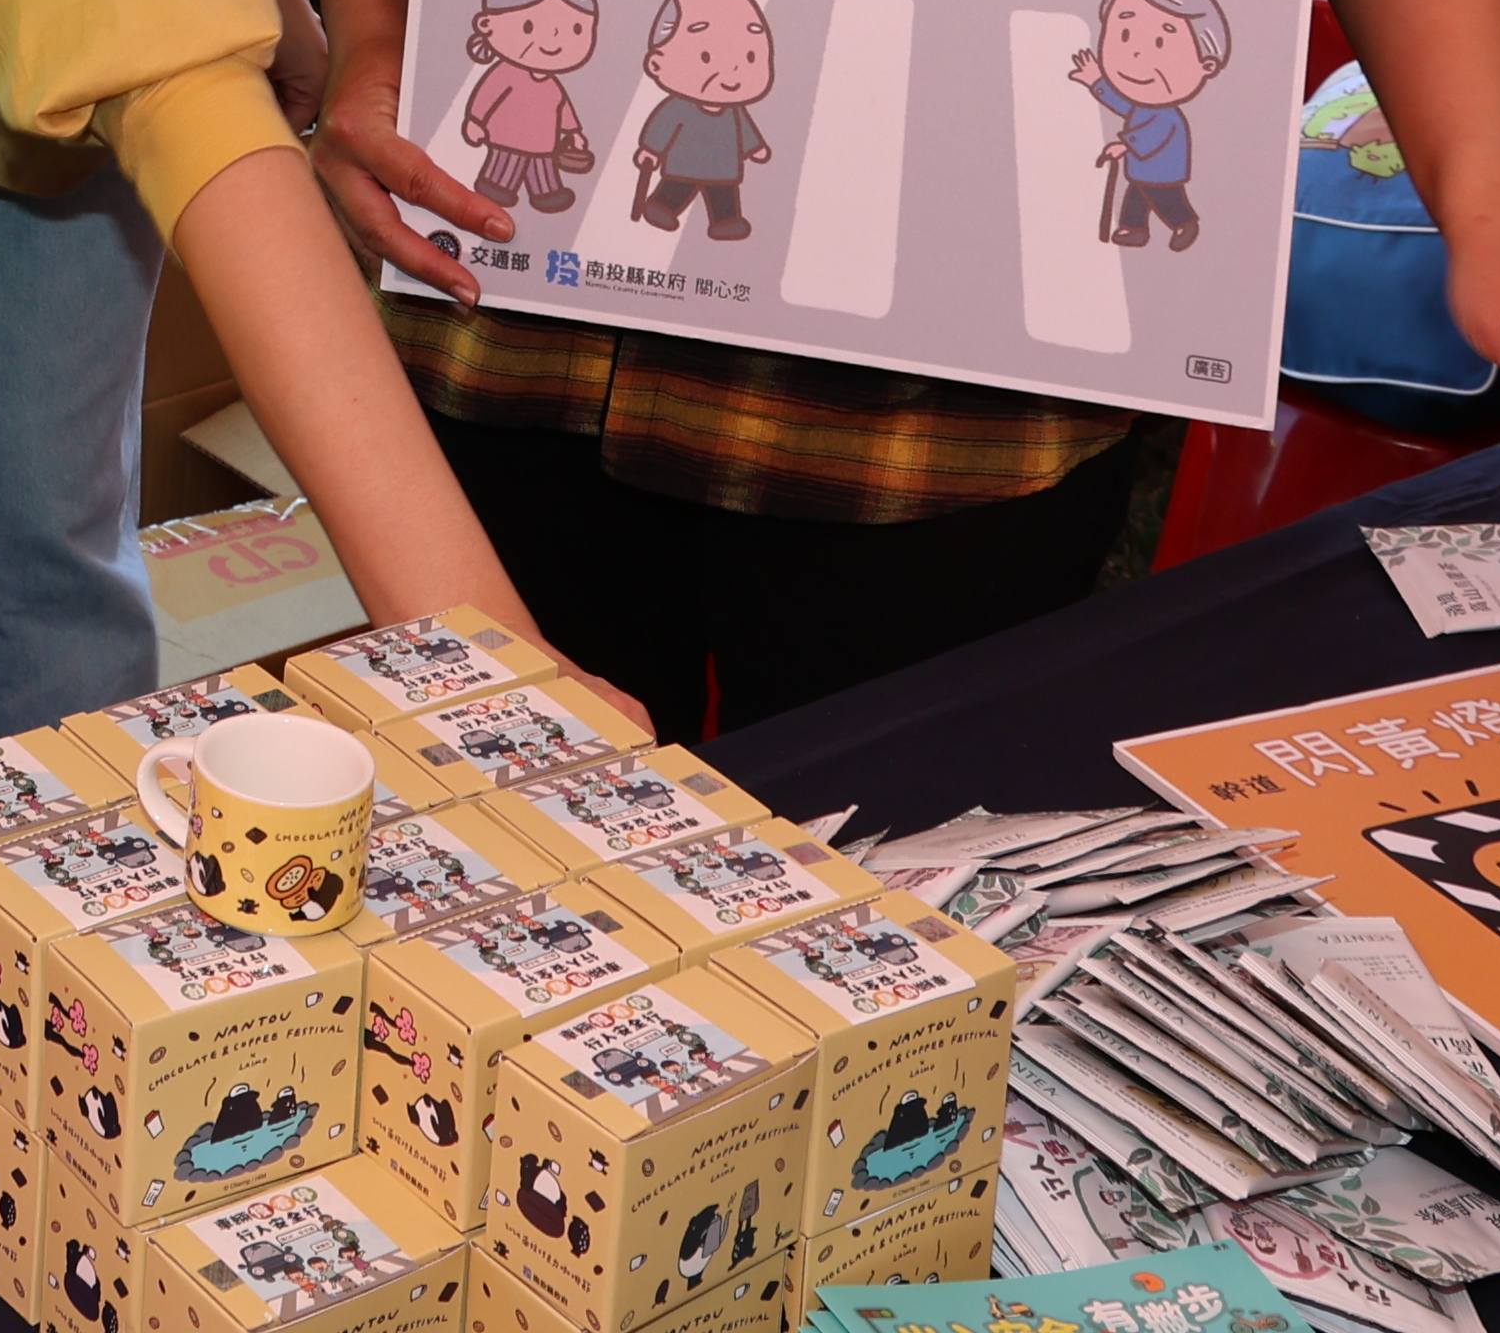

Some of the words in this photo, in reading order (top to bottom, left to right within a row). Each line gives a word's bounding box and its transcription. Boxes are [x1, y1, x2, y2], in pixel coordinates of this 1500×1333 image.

[469, 246, 530, 273] 交通部
[585, 260, 687, 294] 南投縣政府
[694, 277, 752, 303] 關心您
[1191, 359, 1226, 380] 廣告
[1209, 773, 1288, 803] 幹道
[214, 1010, 292, 1042] NANTOU
[890, 1016, 956, 1051] NANTOU
[1063, 1007, 1142, 1065] SCENTEA
[690, 1118, 761, 1159] NANTOU
